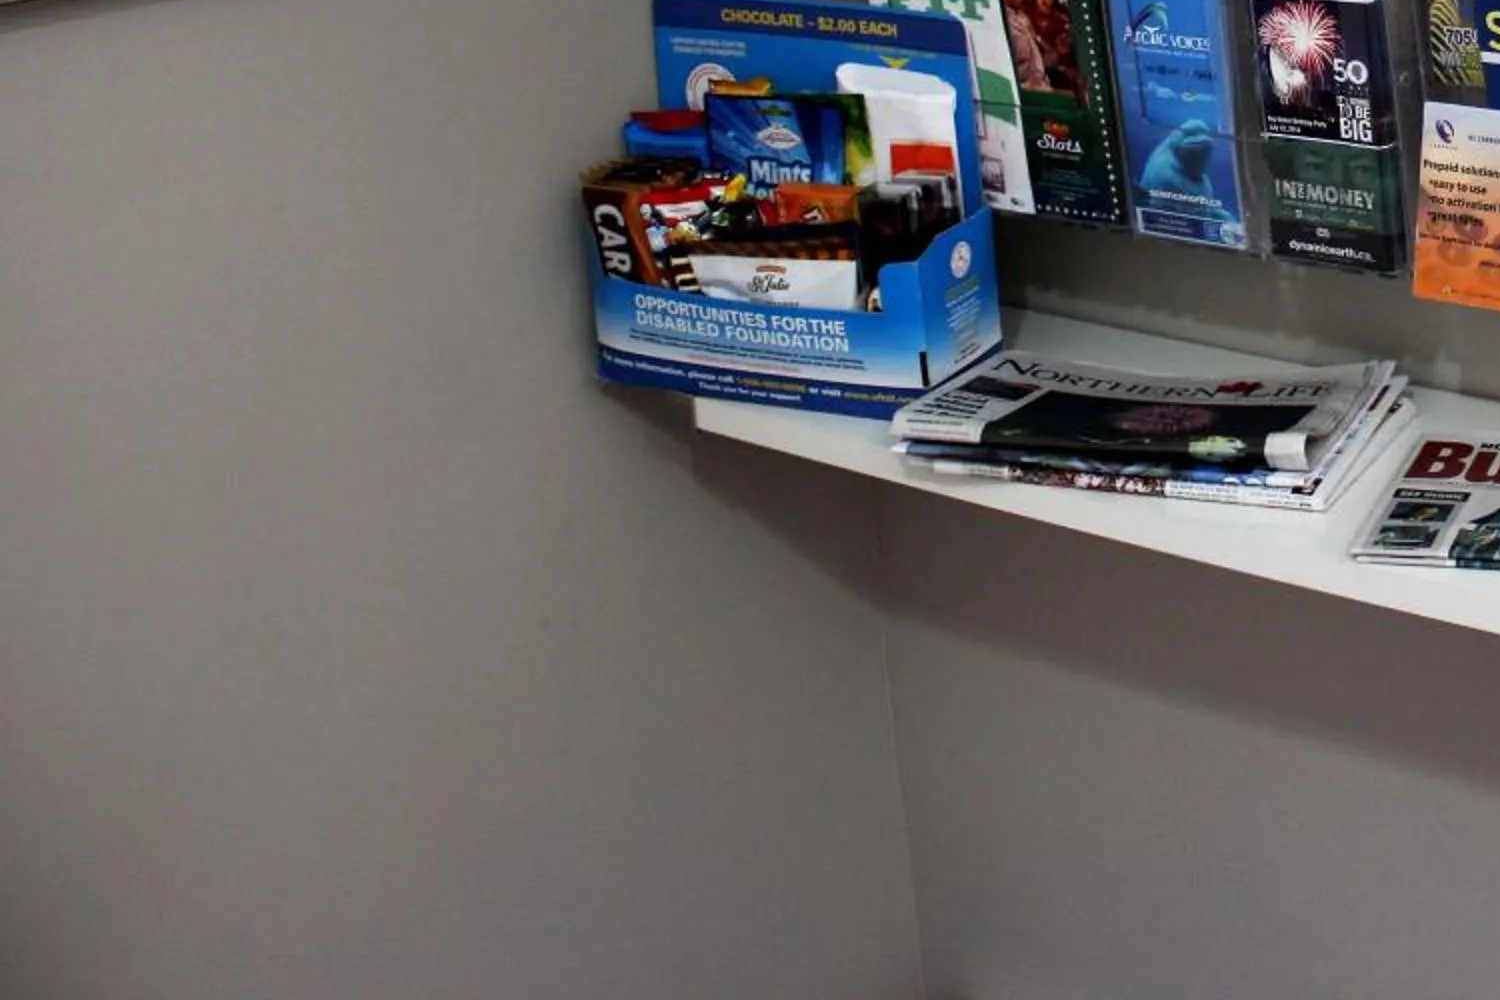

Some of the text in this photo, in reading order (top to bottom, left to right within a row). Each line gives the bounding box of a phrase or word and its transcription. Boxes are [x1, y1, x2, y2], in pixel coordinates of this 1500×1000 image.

[720, 7, 804, 29] CHOCOLATE
[817, 16, 856, 34] $2.00
[860, 20, 898, 38] EACH
[1333, 57, 1370, 85] 50
[1355, 104, 1372, 120] BE
[1340, 117, 1373, 142] BIG
[750, 159, 812, 184] Mints
[1423, 158, 1459, 174] Prepaid
[1457, 181, 1467, 192] to
[1469, 184, 1488, 196] use
[1446, 196, 1498, 213] activation
[593, 203, 633, 283] CAR
[635, 293, 847, 336] OPPORTUNITIES FOR THE
[636, 310, 720, 338] DISABLED
[725, 325, 849, 353] FOUNDATION
[993, 358, 1218, 398] NORTHERN
